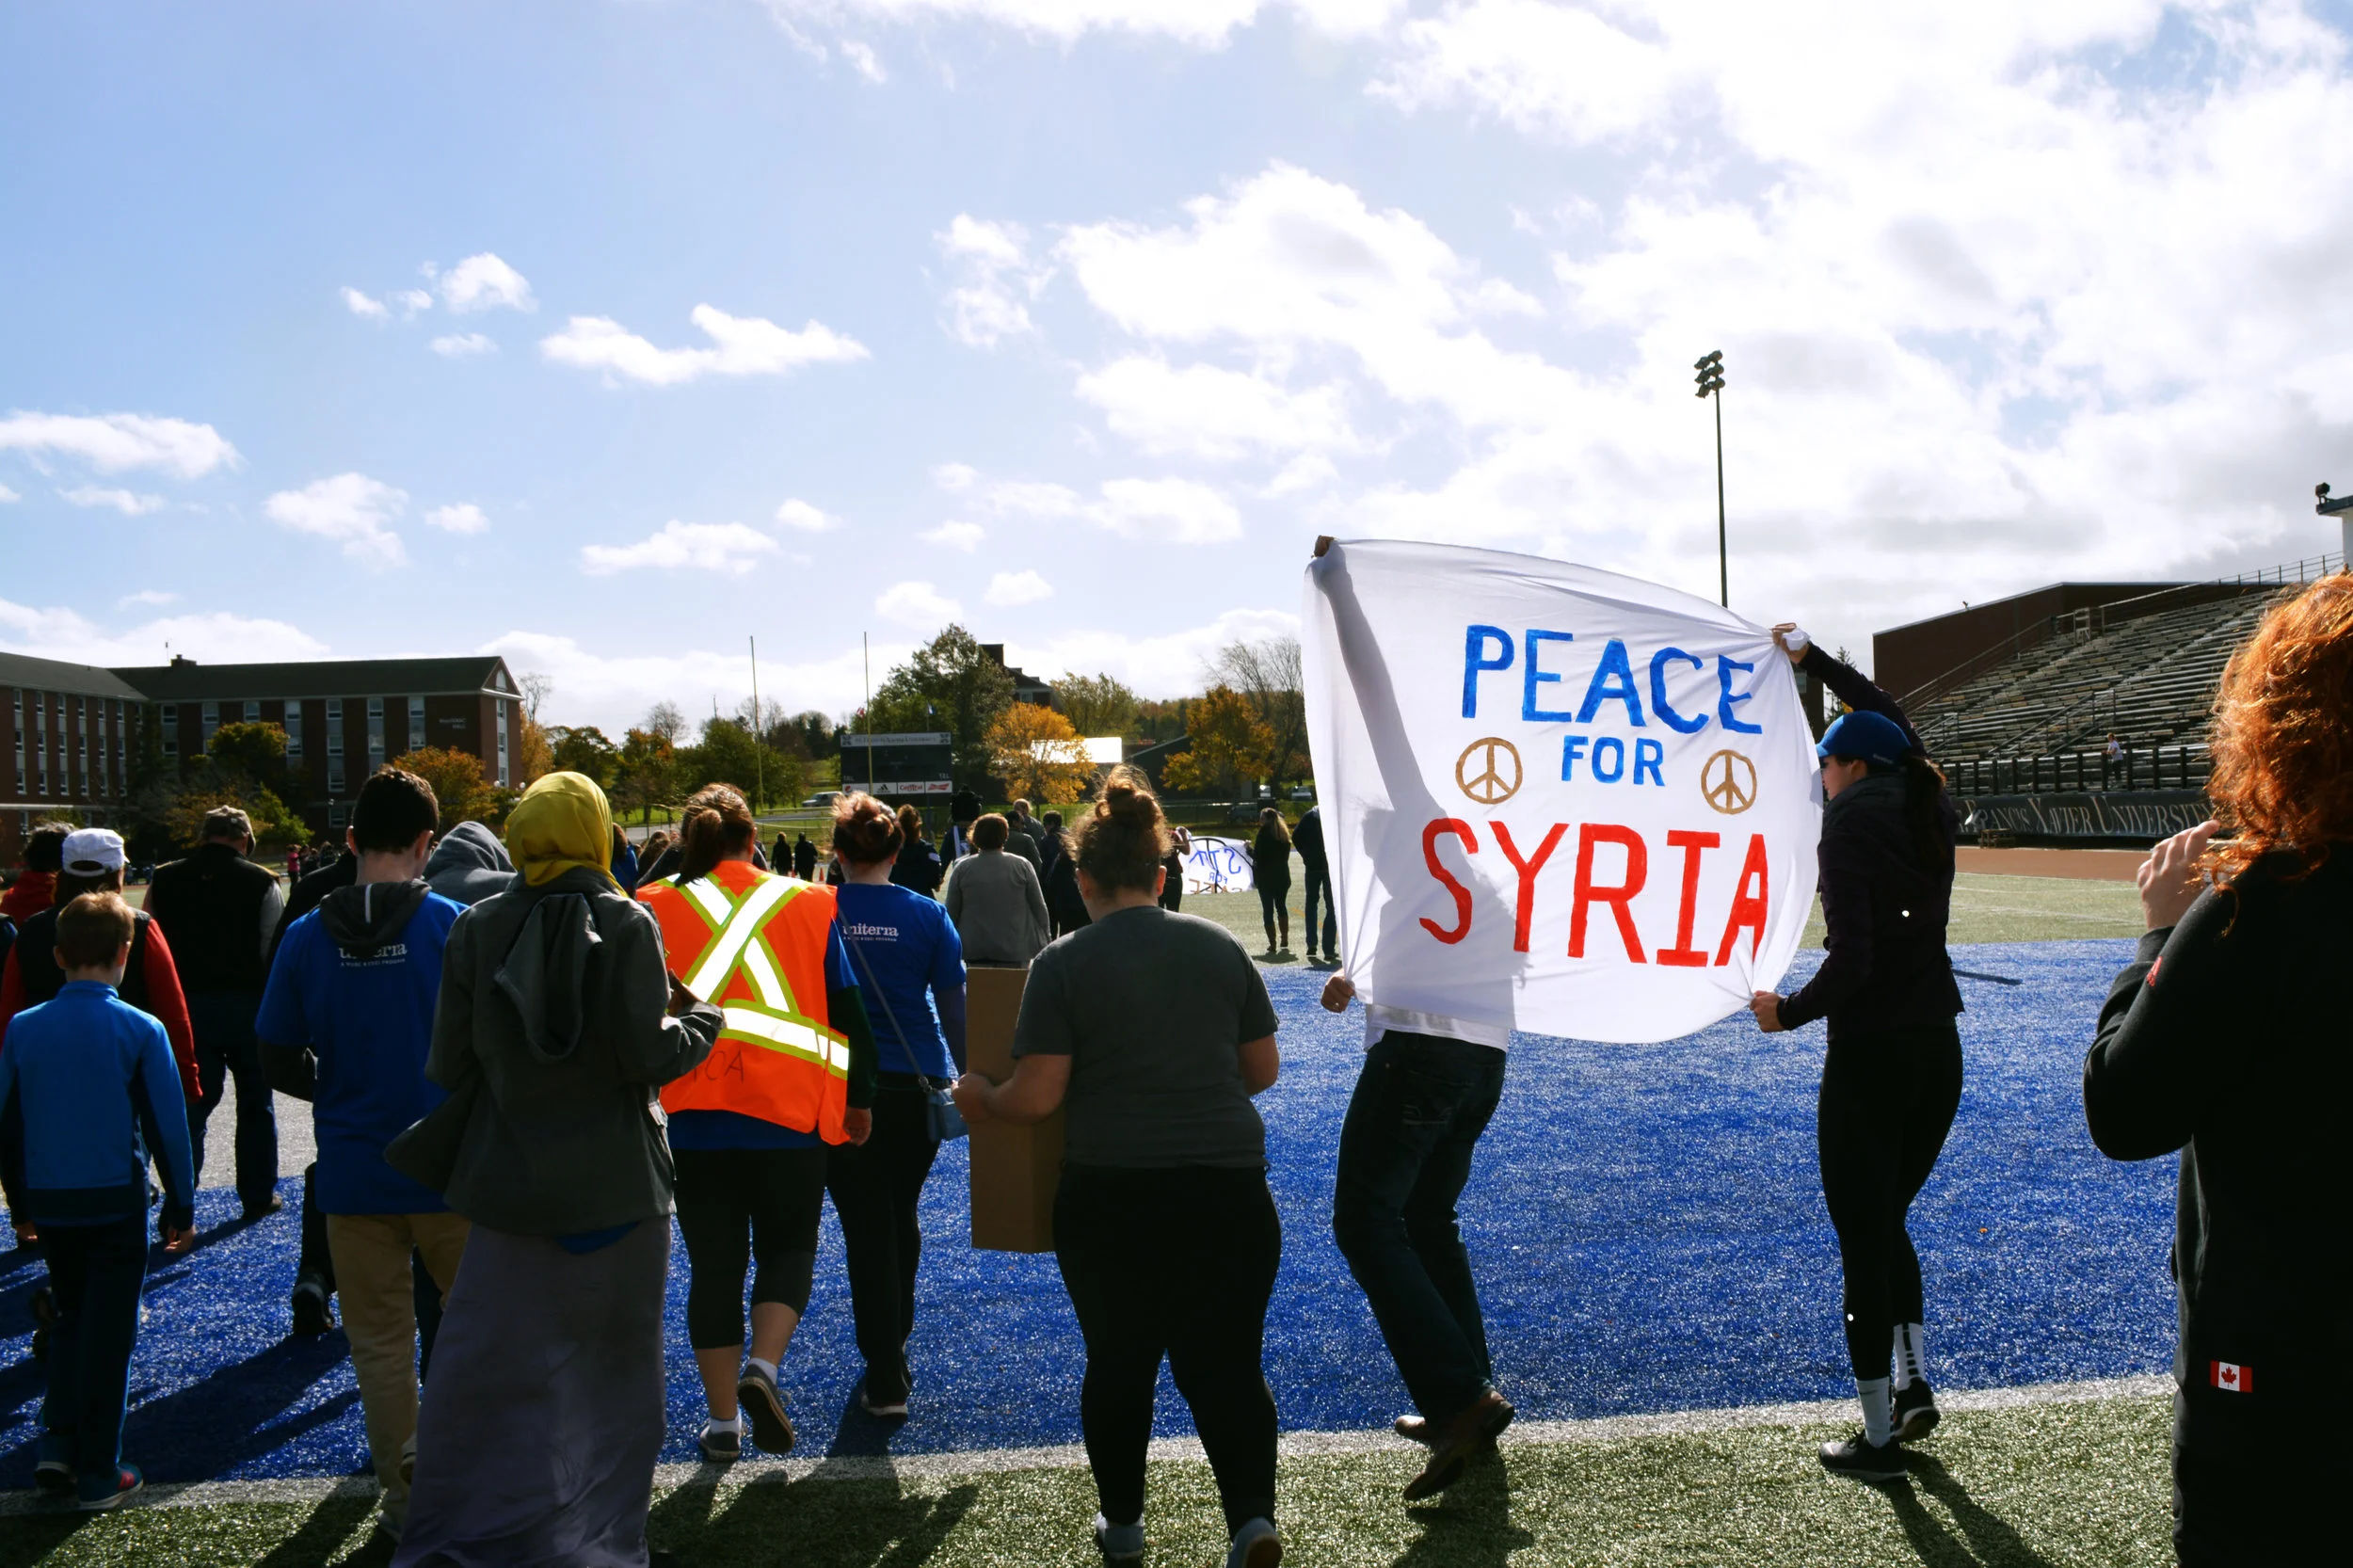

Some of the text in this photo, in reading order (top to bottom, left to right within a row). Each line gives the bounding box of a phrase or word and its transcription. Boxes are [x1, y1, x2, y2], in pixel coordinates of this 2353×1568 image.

[1462, 625, 1763, 734] PEACE
[1561, 735, 1665, 786] FOR
[2027, 797, 2091, 835] XAVIER
[1419, 818, 1769, 967] SYRIA
